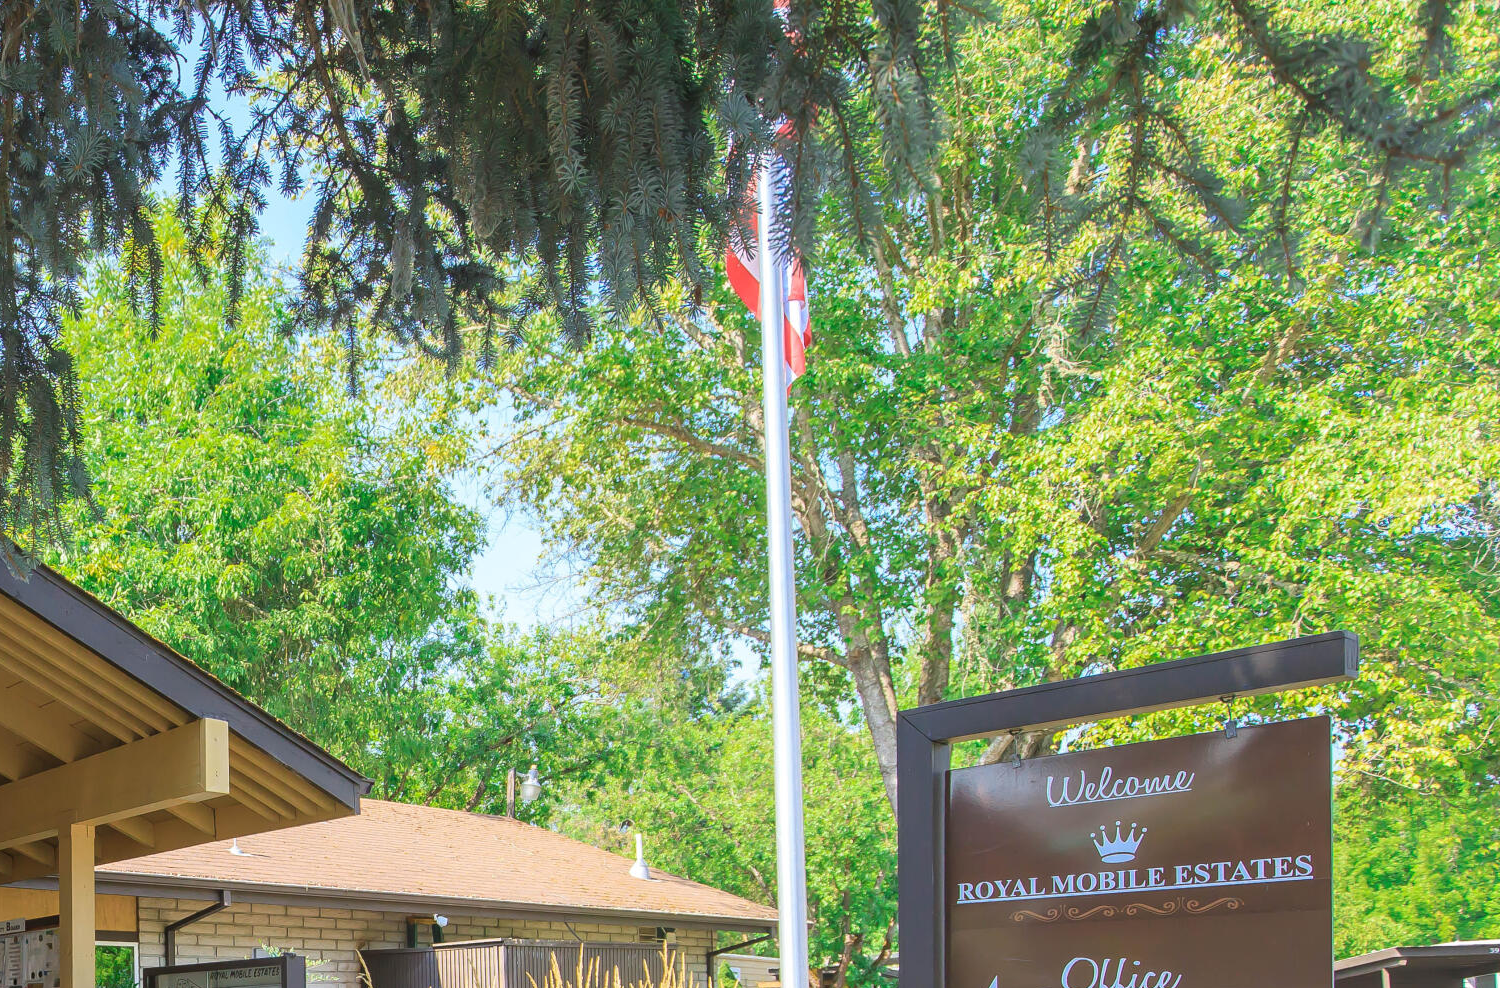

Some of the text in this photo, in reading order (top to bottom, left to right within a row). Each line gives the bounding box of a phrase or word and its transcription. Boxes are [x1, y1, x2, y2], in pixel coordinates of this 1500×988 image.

[1045, 766, 1195, 807] Welcome
[957, 854, 1314, 901] ROYAL MOBILE ESTATES
[210, 966, 280, 980] ROYAL MOBILE ESTATES
